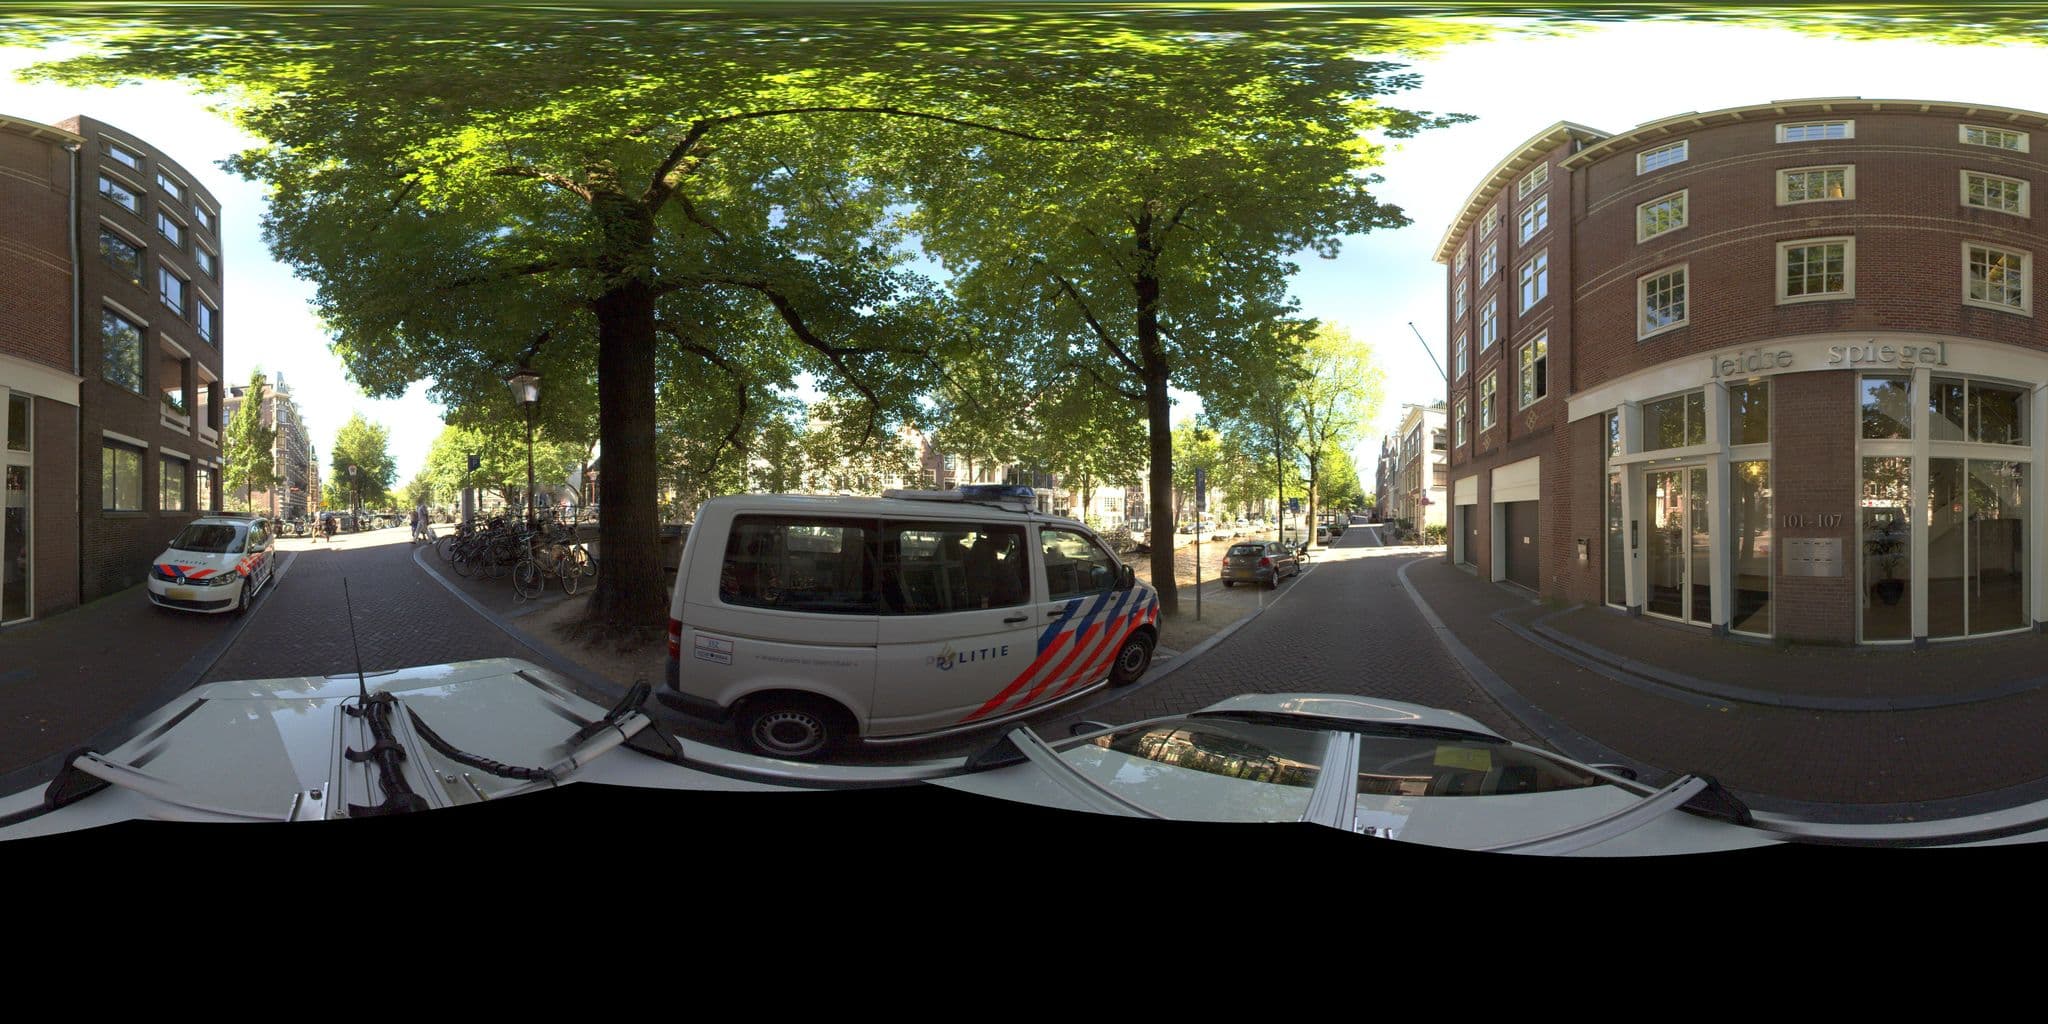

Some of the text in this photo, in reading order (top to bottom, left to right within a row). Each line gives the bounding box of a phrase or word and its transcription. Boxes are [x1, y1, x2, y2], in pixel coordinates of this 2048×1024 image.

[1710, 338, 1948, 378] leidse spiegel
[928, 645, 1009, 670] POLITIE
